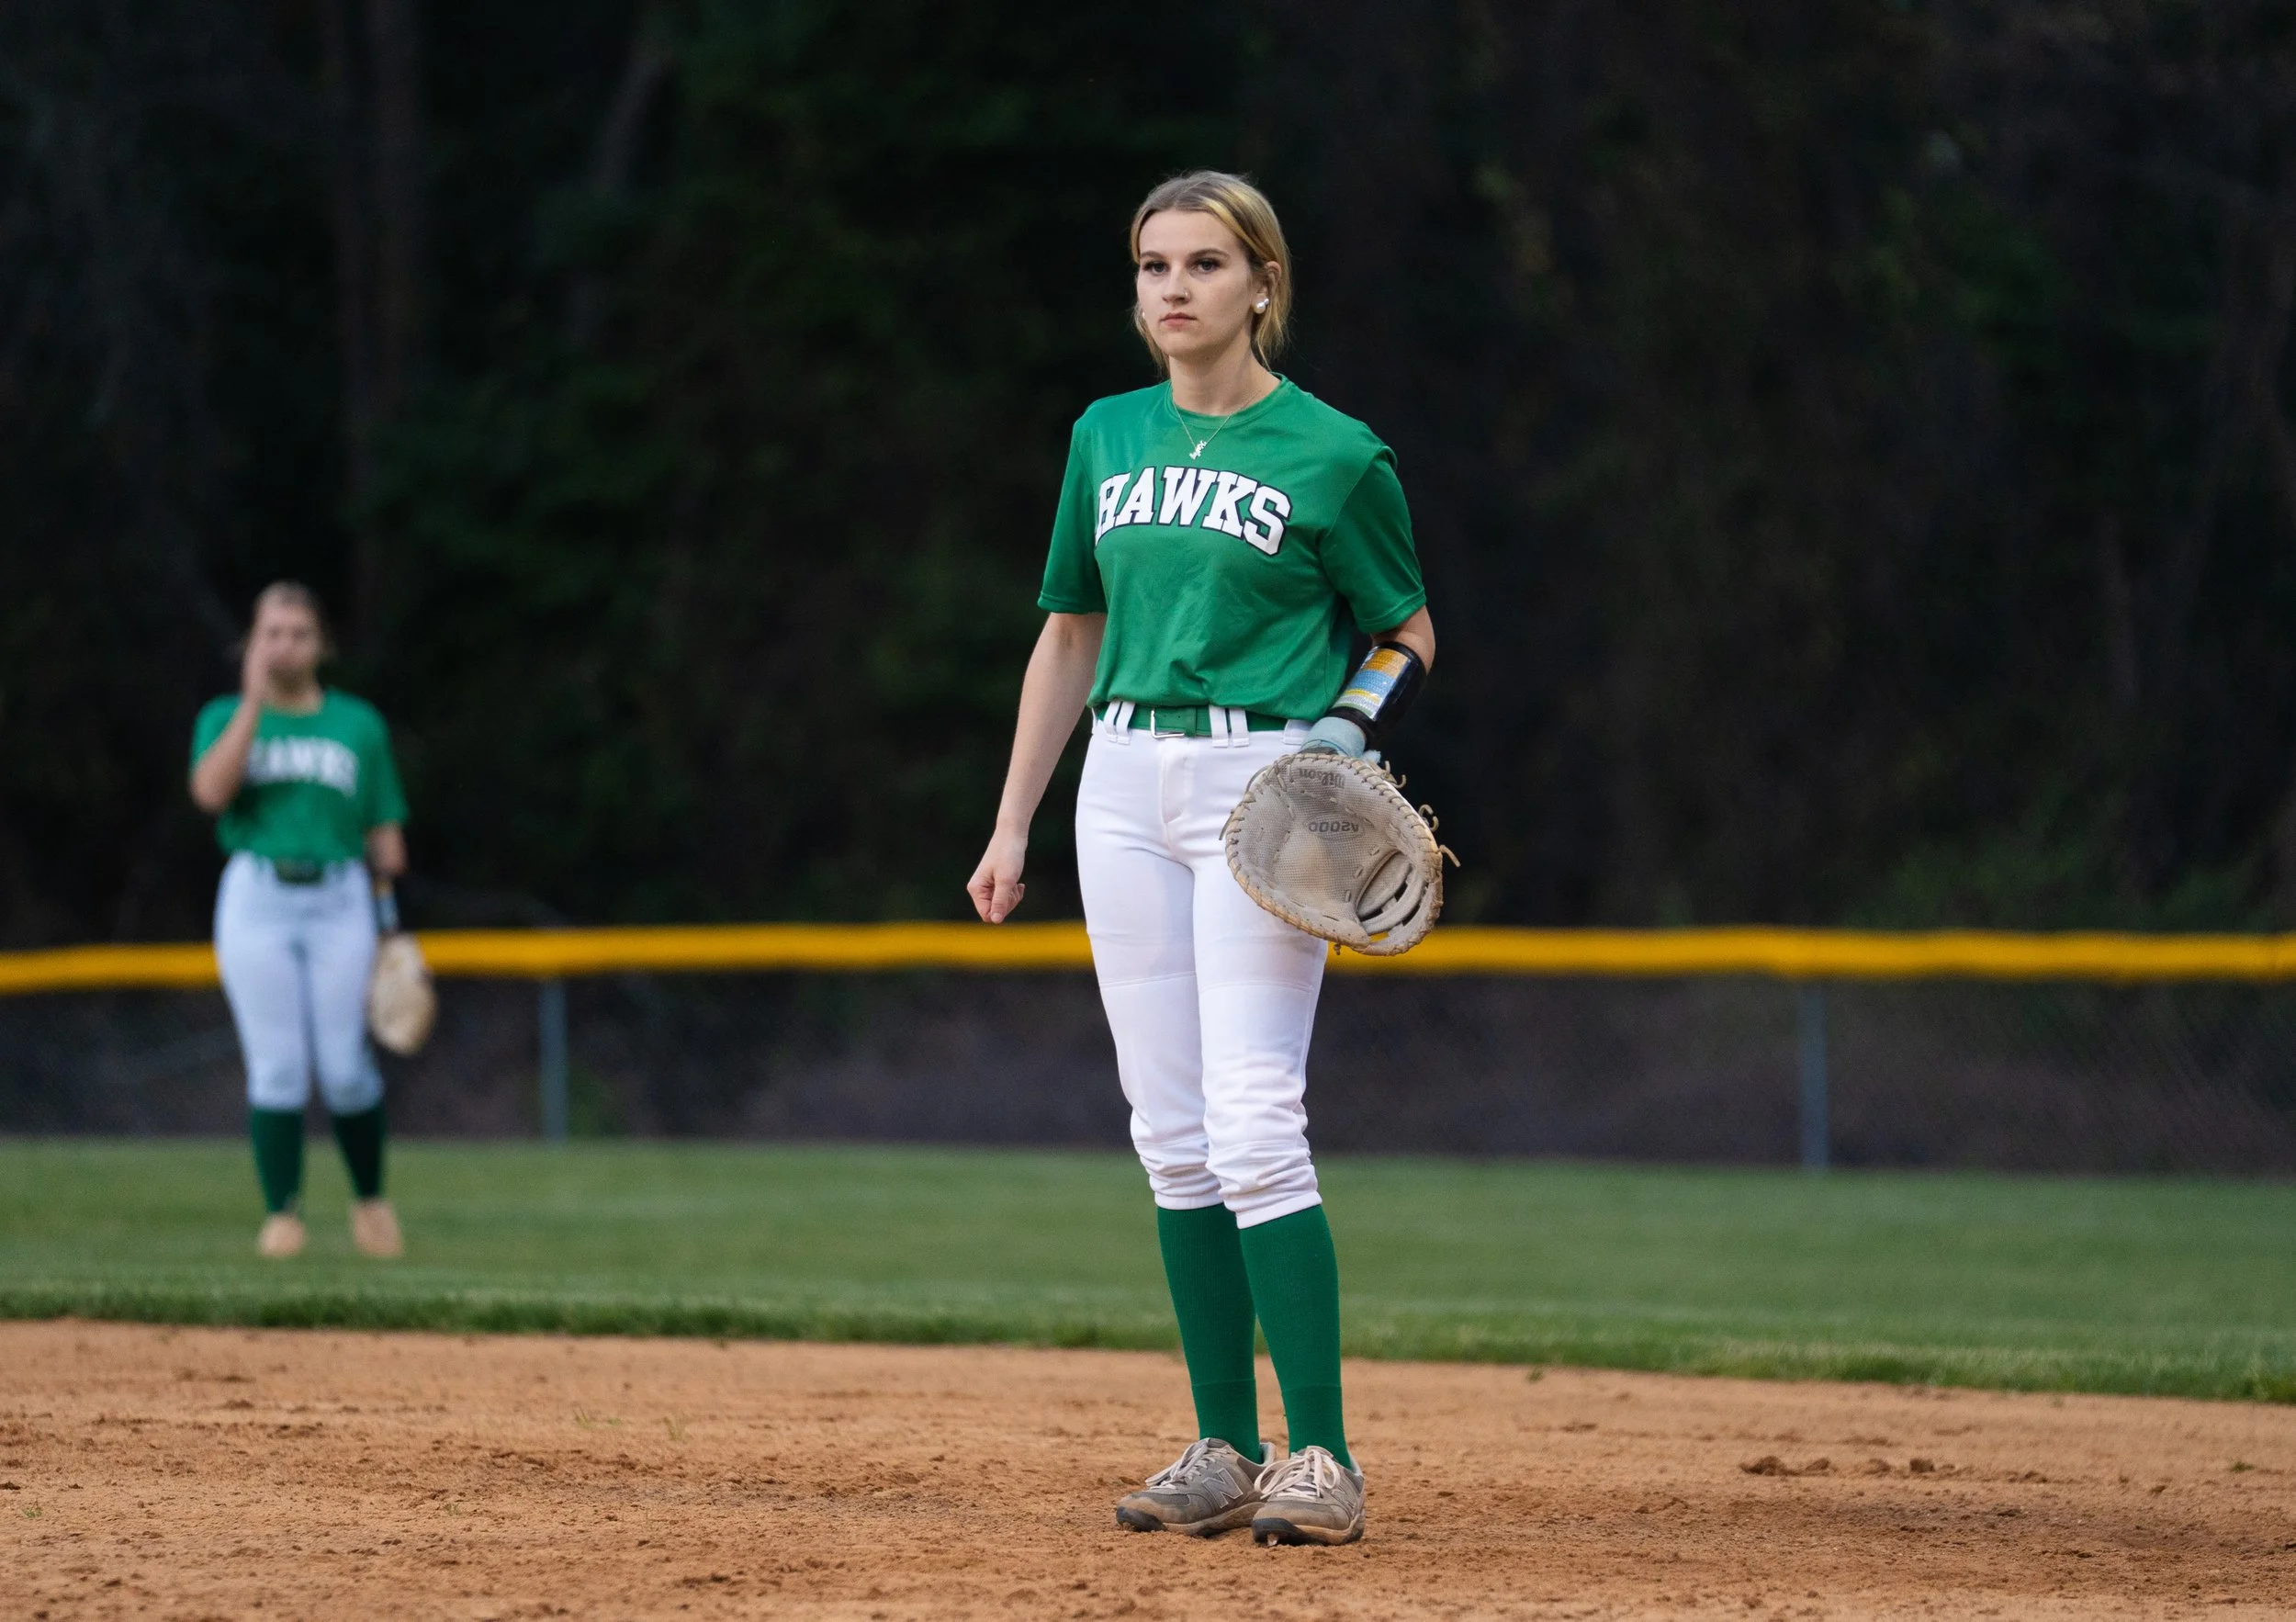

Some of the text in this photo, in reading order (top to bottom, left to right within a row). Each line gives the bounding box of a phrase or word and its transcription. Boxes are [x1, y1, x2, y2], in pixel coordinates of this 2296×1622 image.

[1095, 466, 1293, 556] HAWKS
[1299, 768, 1345, 788] Wilson
[1309, 821, 1359, 832] A2000
